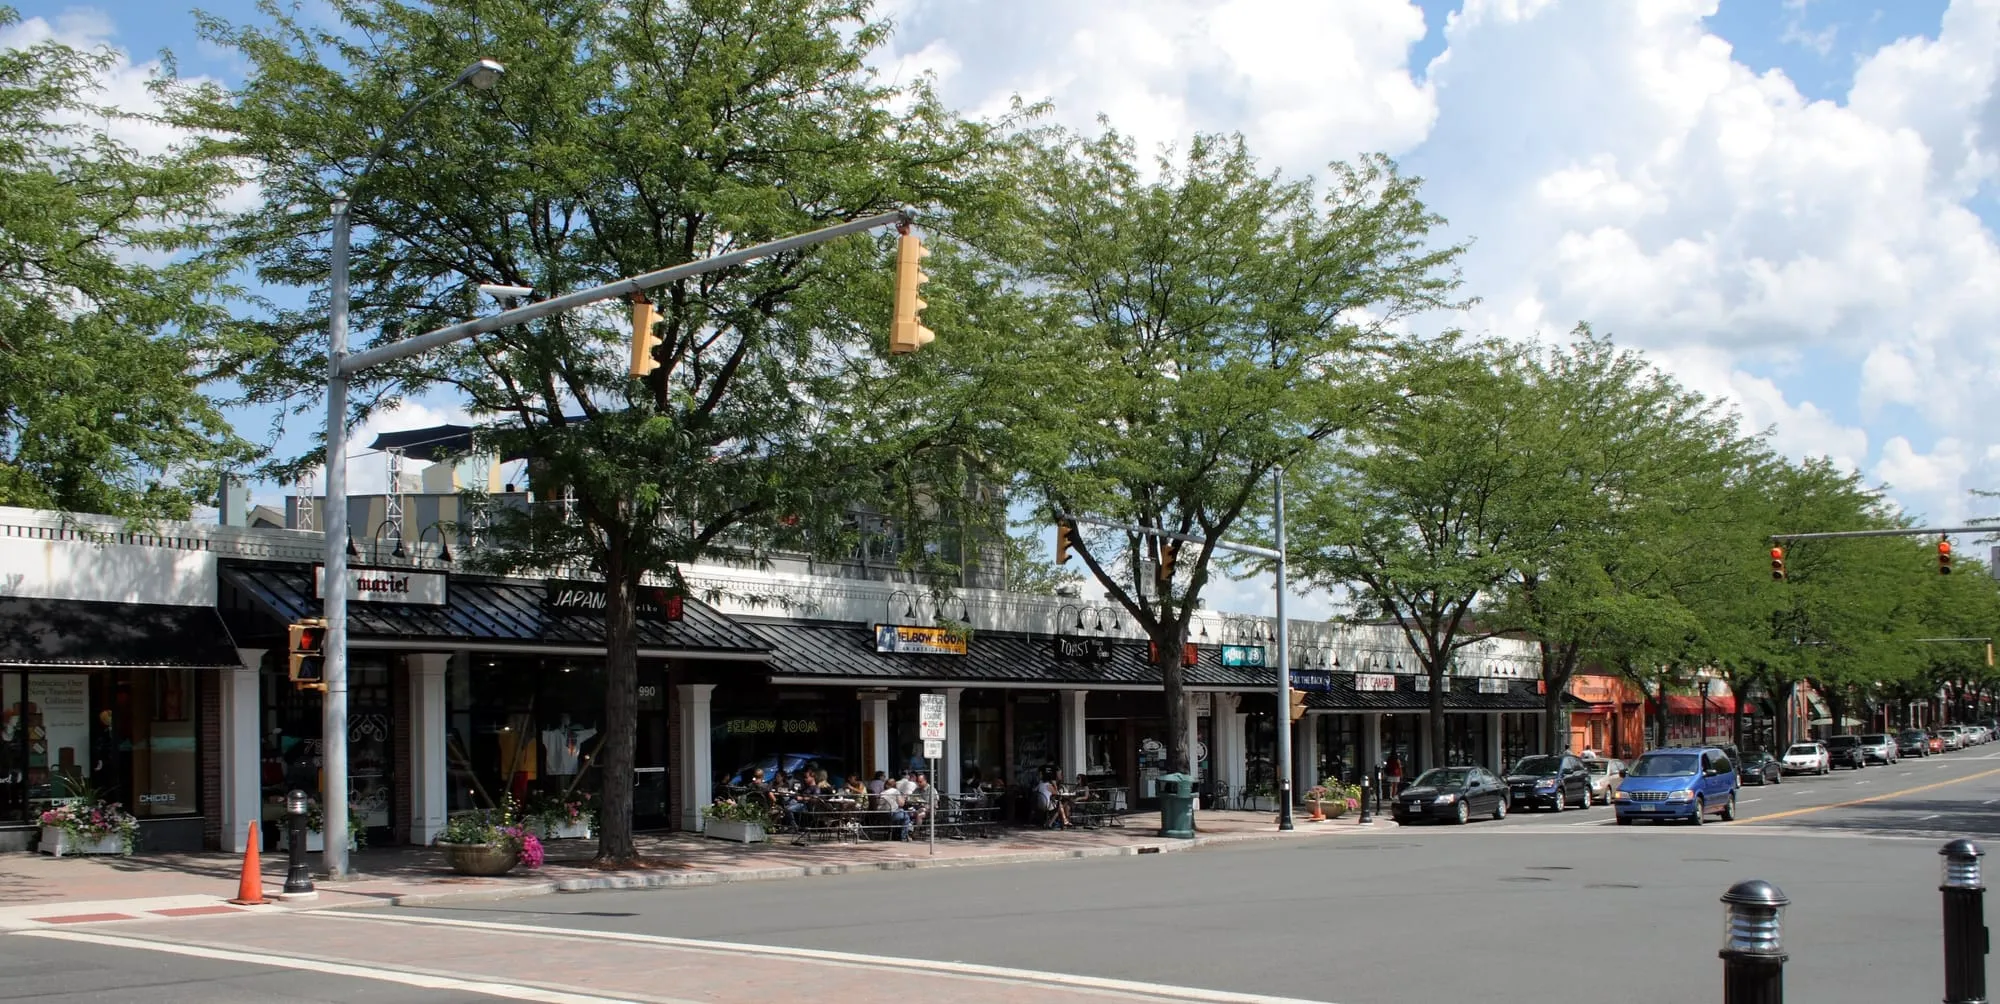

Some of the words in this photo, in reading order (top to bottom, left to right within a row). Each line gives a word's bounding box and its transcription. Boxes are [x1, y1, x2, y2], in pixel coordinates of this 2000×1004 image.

[357, 575, 409, 593] mariel
[553, 590, 607, 608] JAPAN
[901, 632, 933, 643] ELBOW
[1060, 638, 1089, 657] TOAST
[1371, 676, 1393, 688] CAMERA
[639, 686, 655, 696] 990
[733, 719, 776, 733] ELBOW
[927, 729, 940, 737] ONLY
[139, 794, 176, 803] CHICO'S
